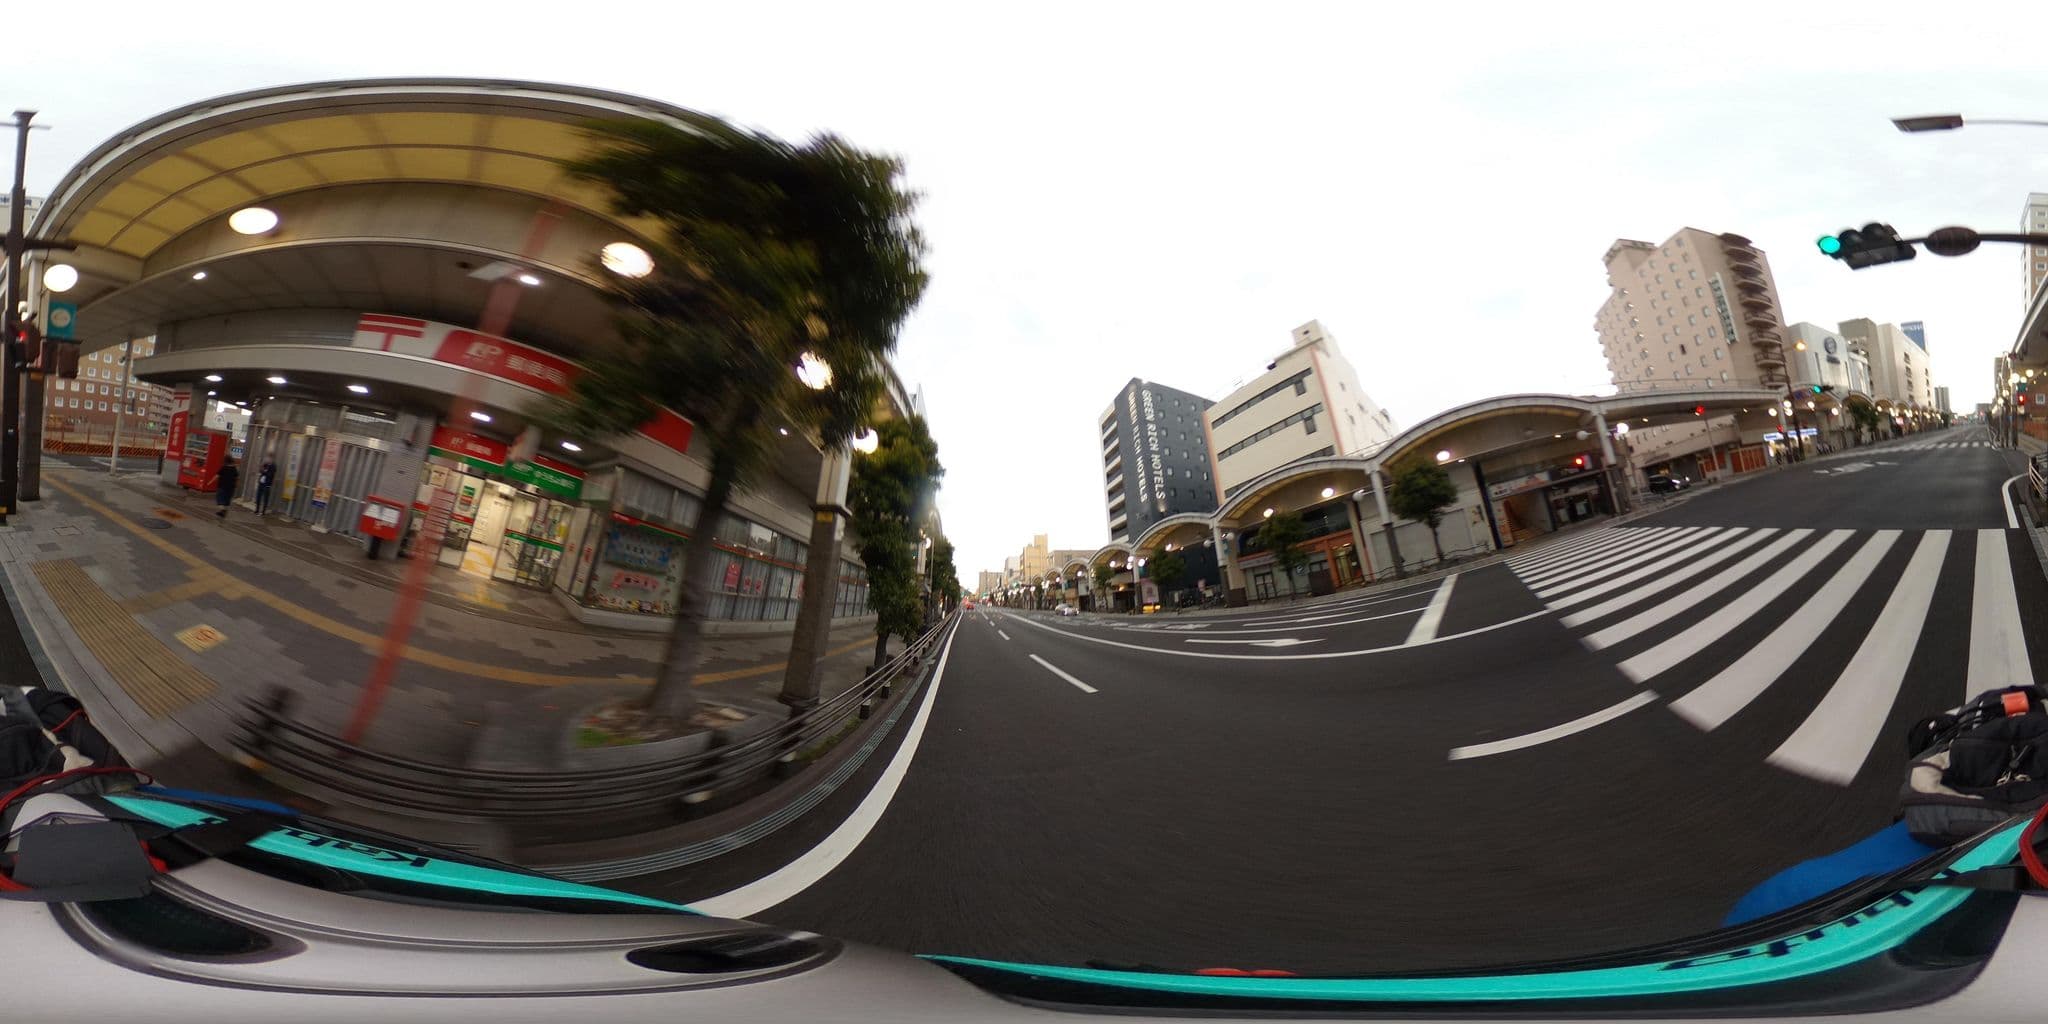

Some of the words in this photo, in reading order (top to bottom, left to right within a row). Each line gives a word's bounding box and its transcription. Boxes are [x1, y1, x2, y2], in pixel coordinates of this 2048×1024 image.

[1142, 389, 1155, 422] GREEN
[1128, 391, 1138, 425] GREEN
[1136, 457, 1148, 503] HOTELS
[1147, 424, 1160, 452] RICH
[1151, 455, 1166, 500] HOTELS
